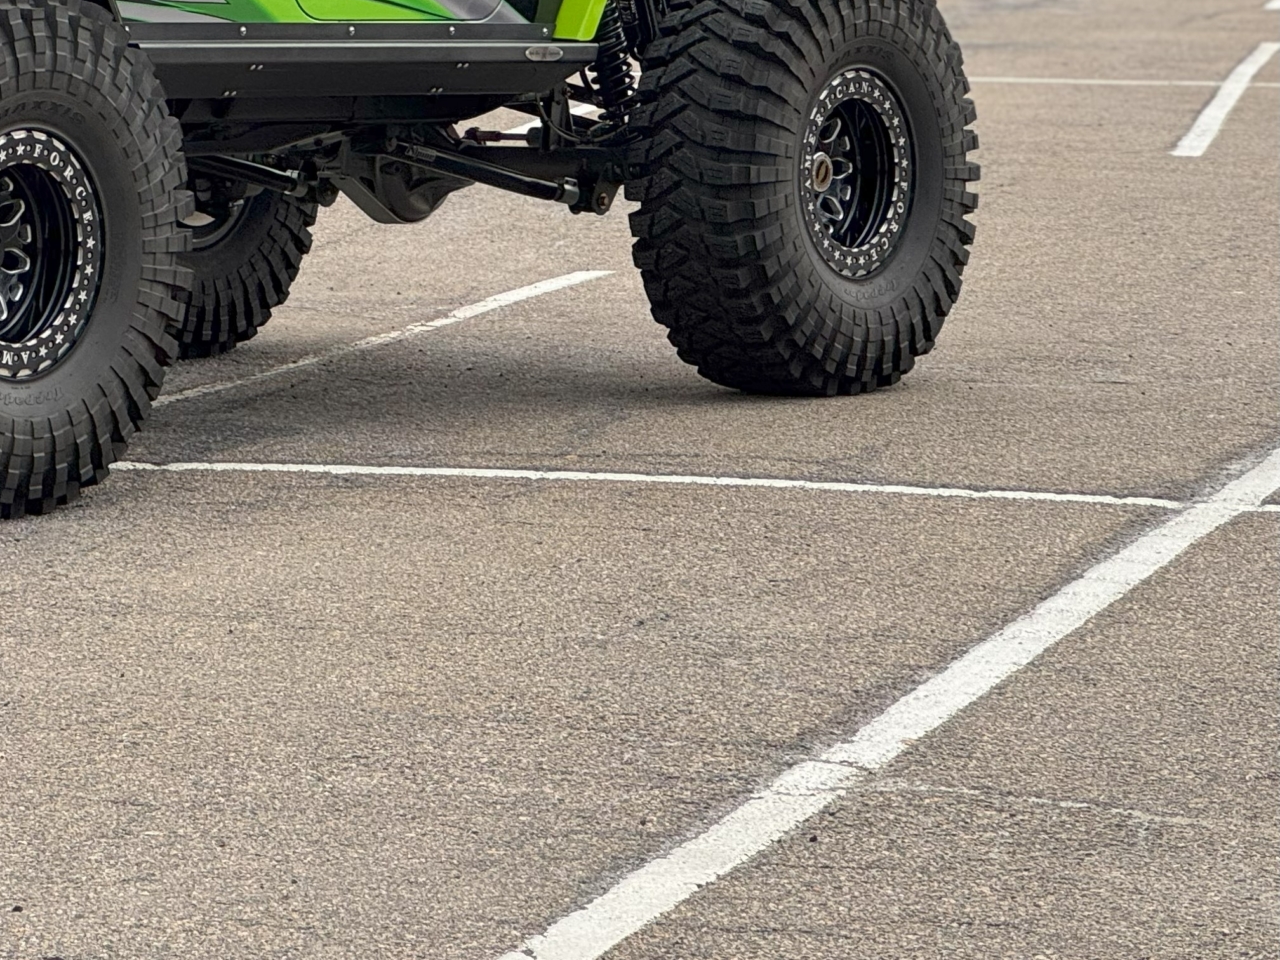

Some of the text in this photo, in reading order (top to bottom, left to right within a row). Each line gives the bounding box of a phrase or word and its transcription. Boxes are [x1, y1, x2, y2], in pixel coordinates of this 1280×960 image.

[33, 143, 94, 225] FORCE
[804, 81, 909, 262] AMERICAN FORCE
